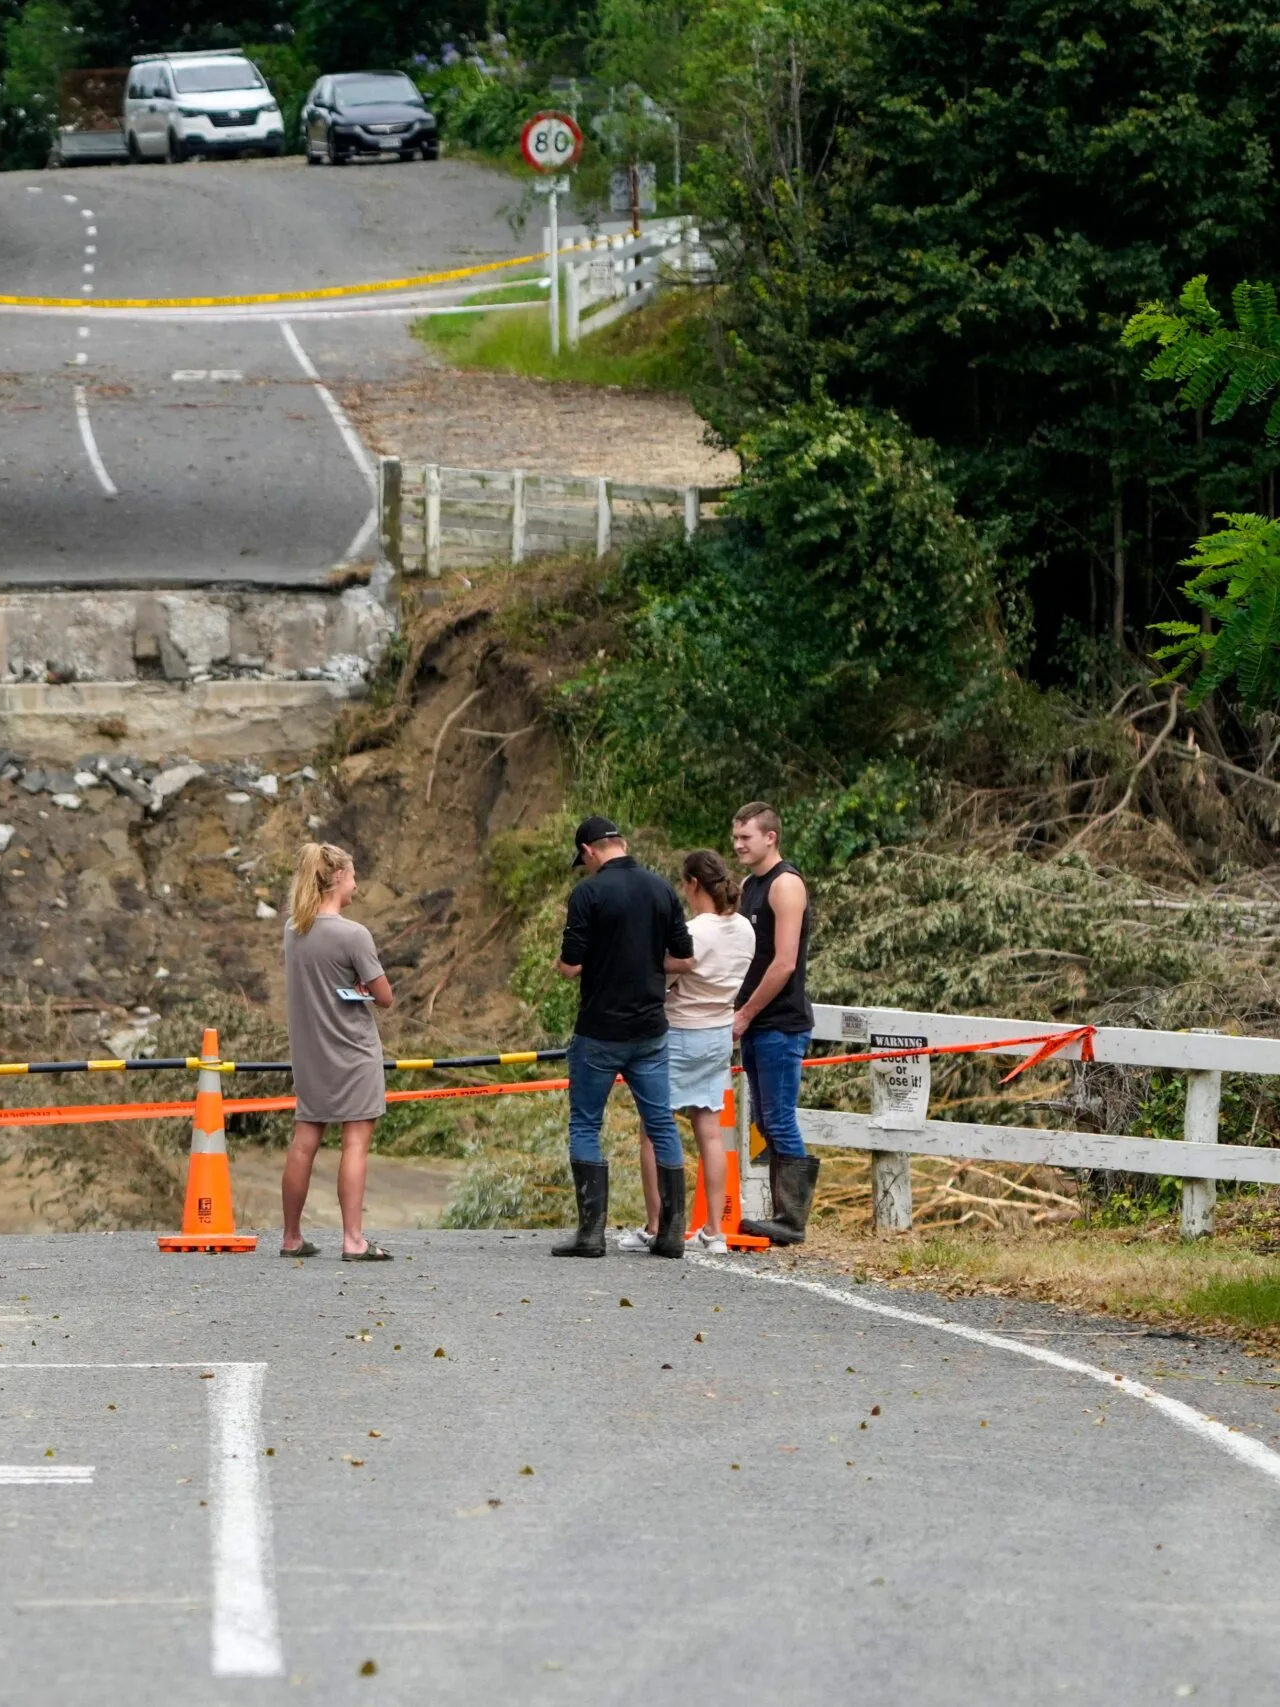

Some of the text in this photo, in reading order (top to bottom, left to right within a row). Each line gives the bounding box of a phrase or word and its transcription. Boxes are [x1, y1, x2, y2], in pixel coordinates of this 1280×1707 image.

[535, 131, 569, 153] 80
[875, 1036, 923, 1048] WARNING
[896, 1066, 907, 1075] or
[911, 1074, 922, 1088] it!
